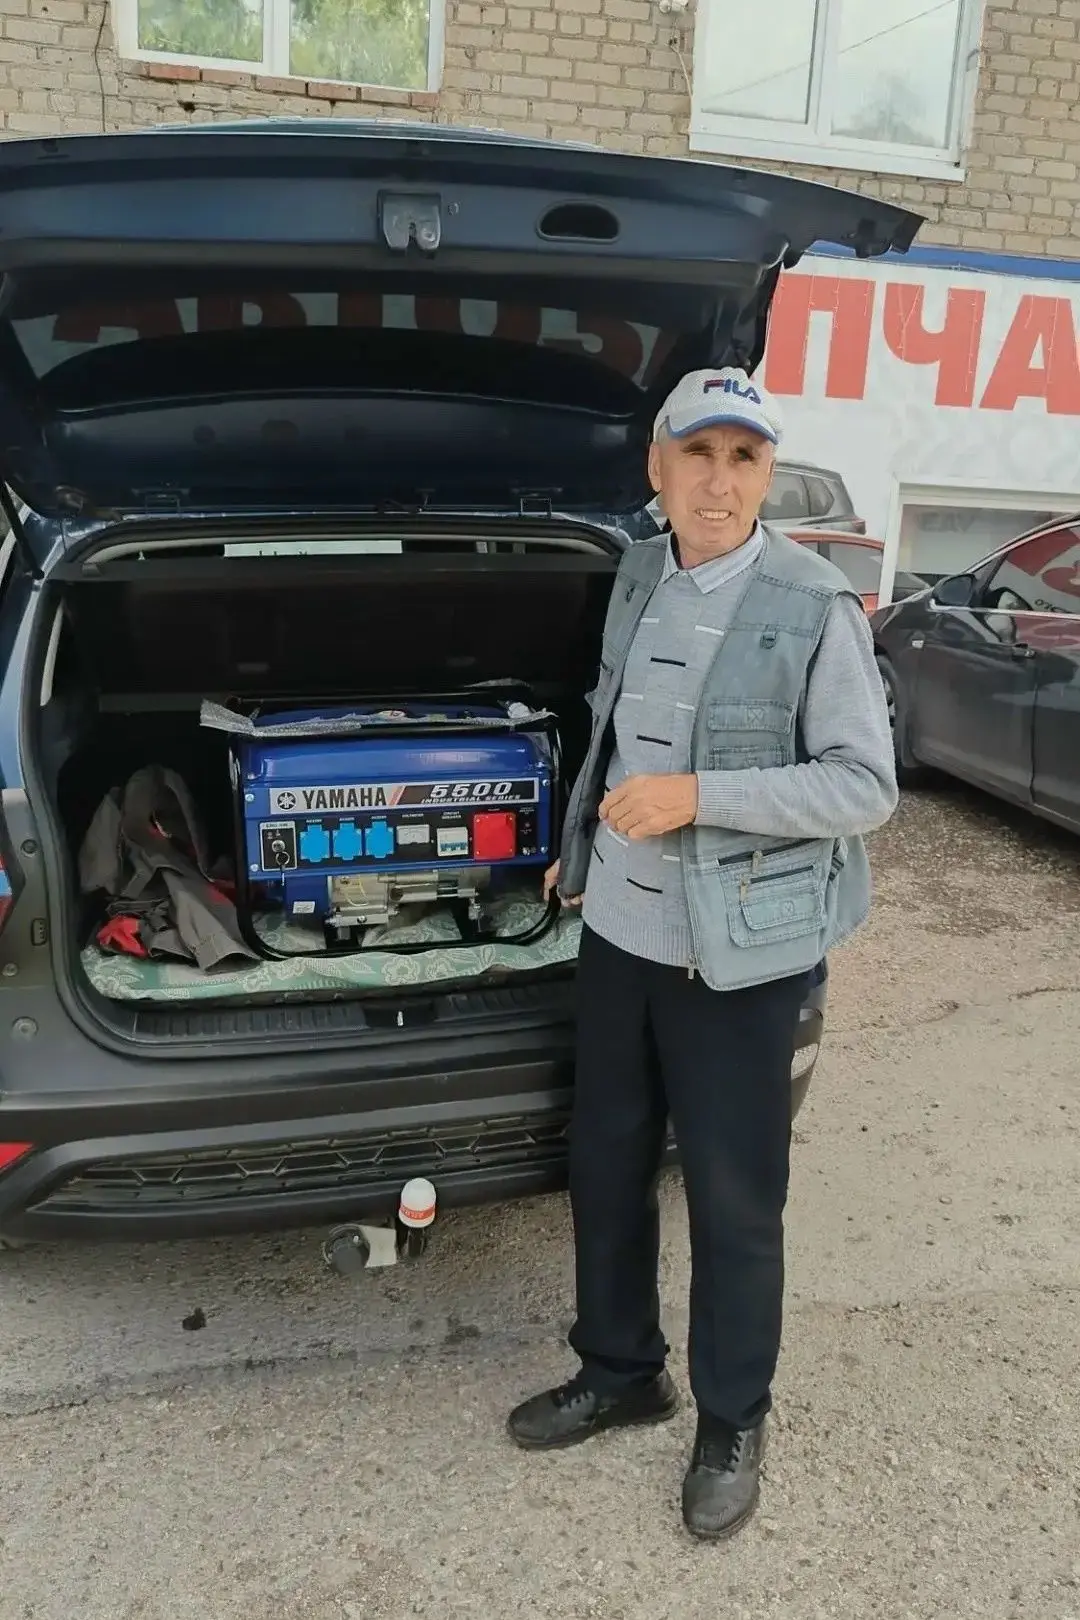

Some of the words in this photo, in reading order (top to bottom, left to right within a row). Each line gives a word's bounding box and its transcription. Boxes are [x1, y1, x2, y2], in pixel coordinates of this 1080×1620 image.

[703, 378, 762, 405] FILA
[301, 786, 387, 810] YAMAHA
[421, 795, 480, 804] INDUSTRIAL
[485, 793, 521, 801] SERIES
[430, 781, 513, 799] 5500
